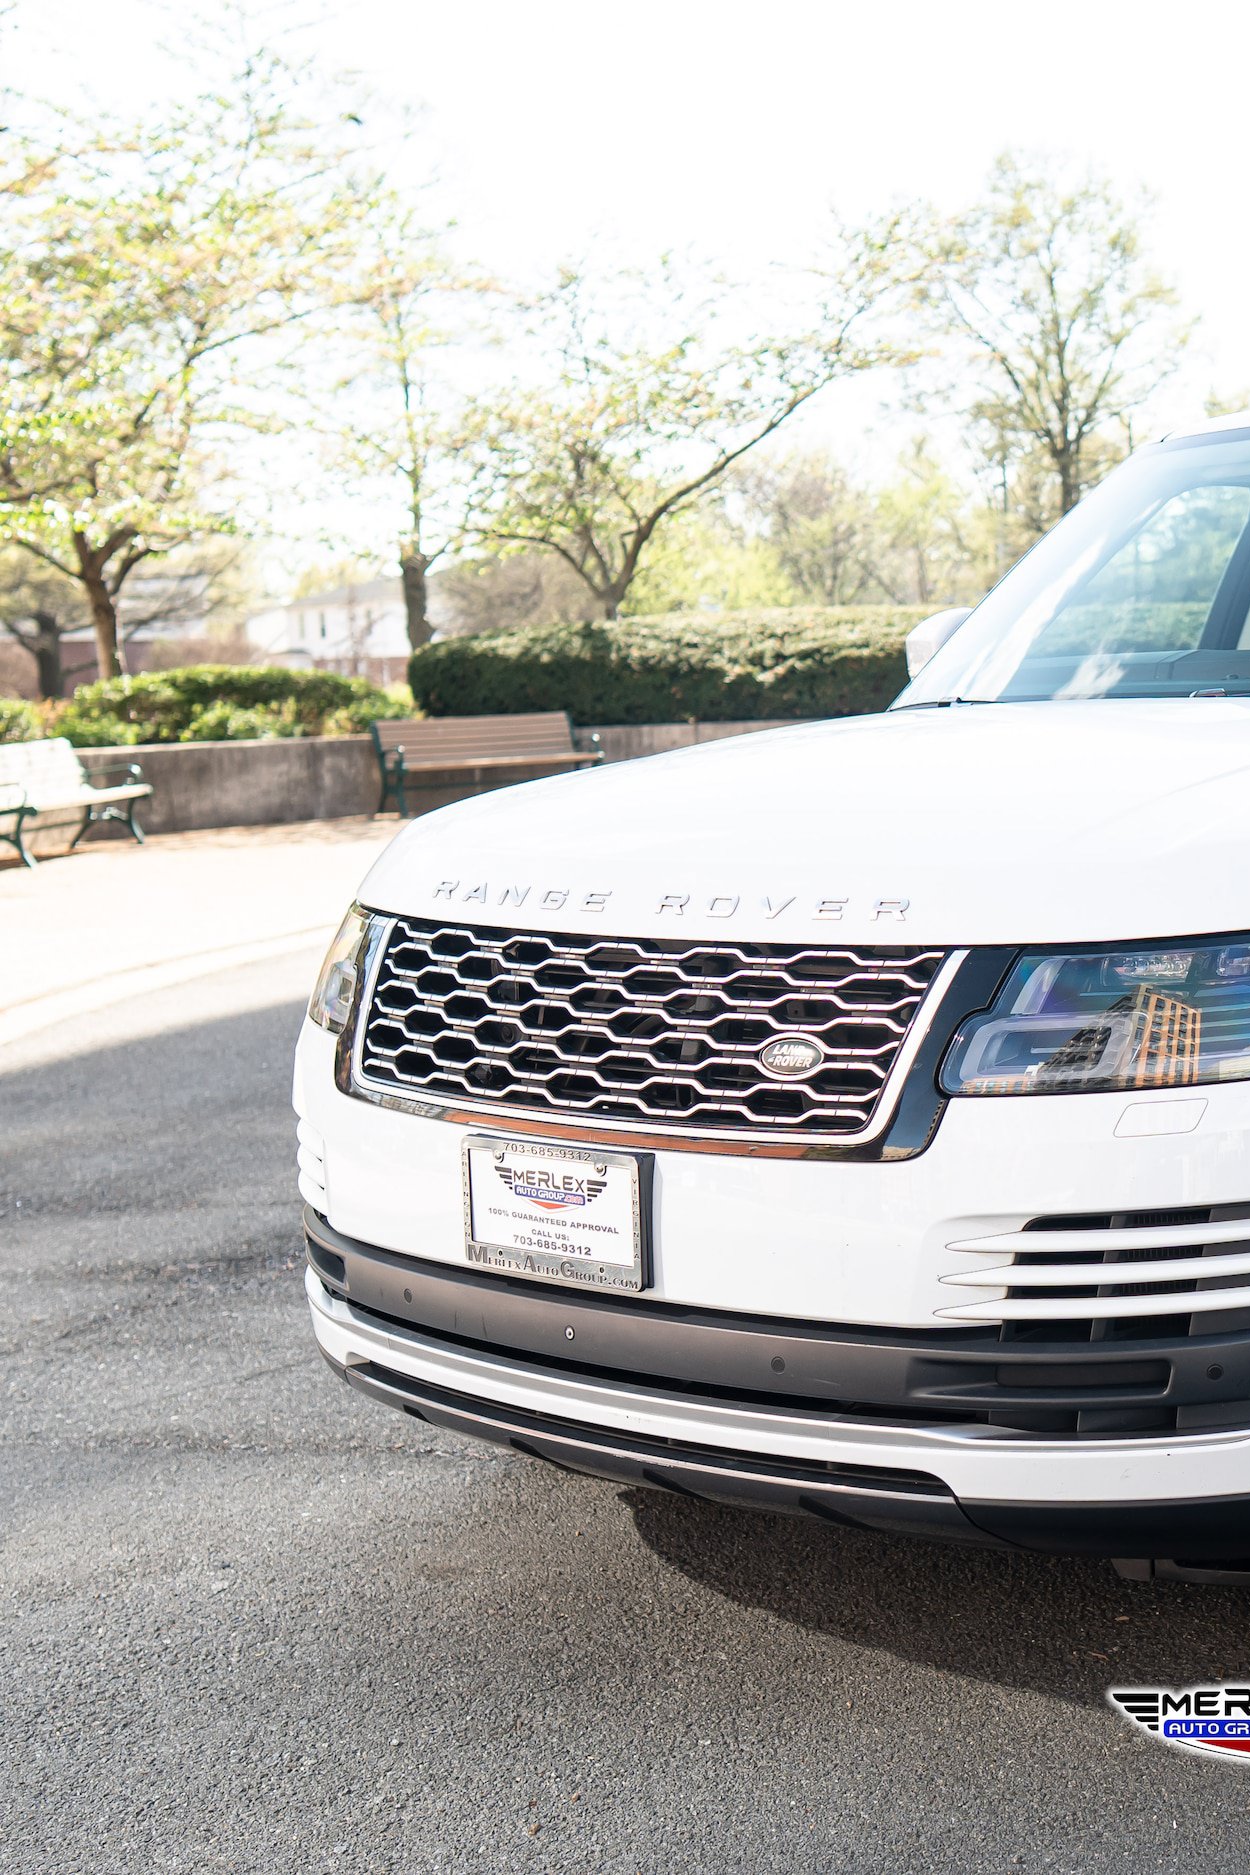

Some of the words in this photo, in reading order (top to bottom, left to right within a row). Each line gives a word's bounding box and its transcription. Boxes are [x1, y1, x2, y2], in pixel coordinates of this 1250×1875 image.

[432, 879, 613, 912] RANGE
[654, 892, 911, 922] ROVER
[772, 1055, 813, 1068] ROVER
[503, 1142, 592, 1162] 703-685-9312
[513, 1170, 585, 1193] MERLEX
[516, 1186, 537, 1197] AUTO
[488, 1207, 510, 1218] 100%
[512, 1211, 568, 1228] GUARANTEED
[570, 1221, 619, 1235] APPROVAL
[632, 1178, 640, 1260] VIRGINIA
[513, 1235, 592, 1256] 703-685-9312
[531, 1229, 552, 1239] CALL
[554, 1232, 570, 1242] US:
